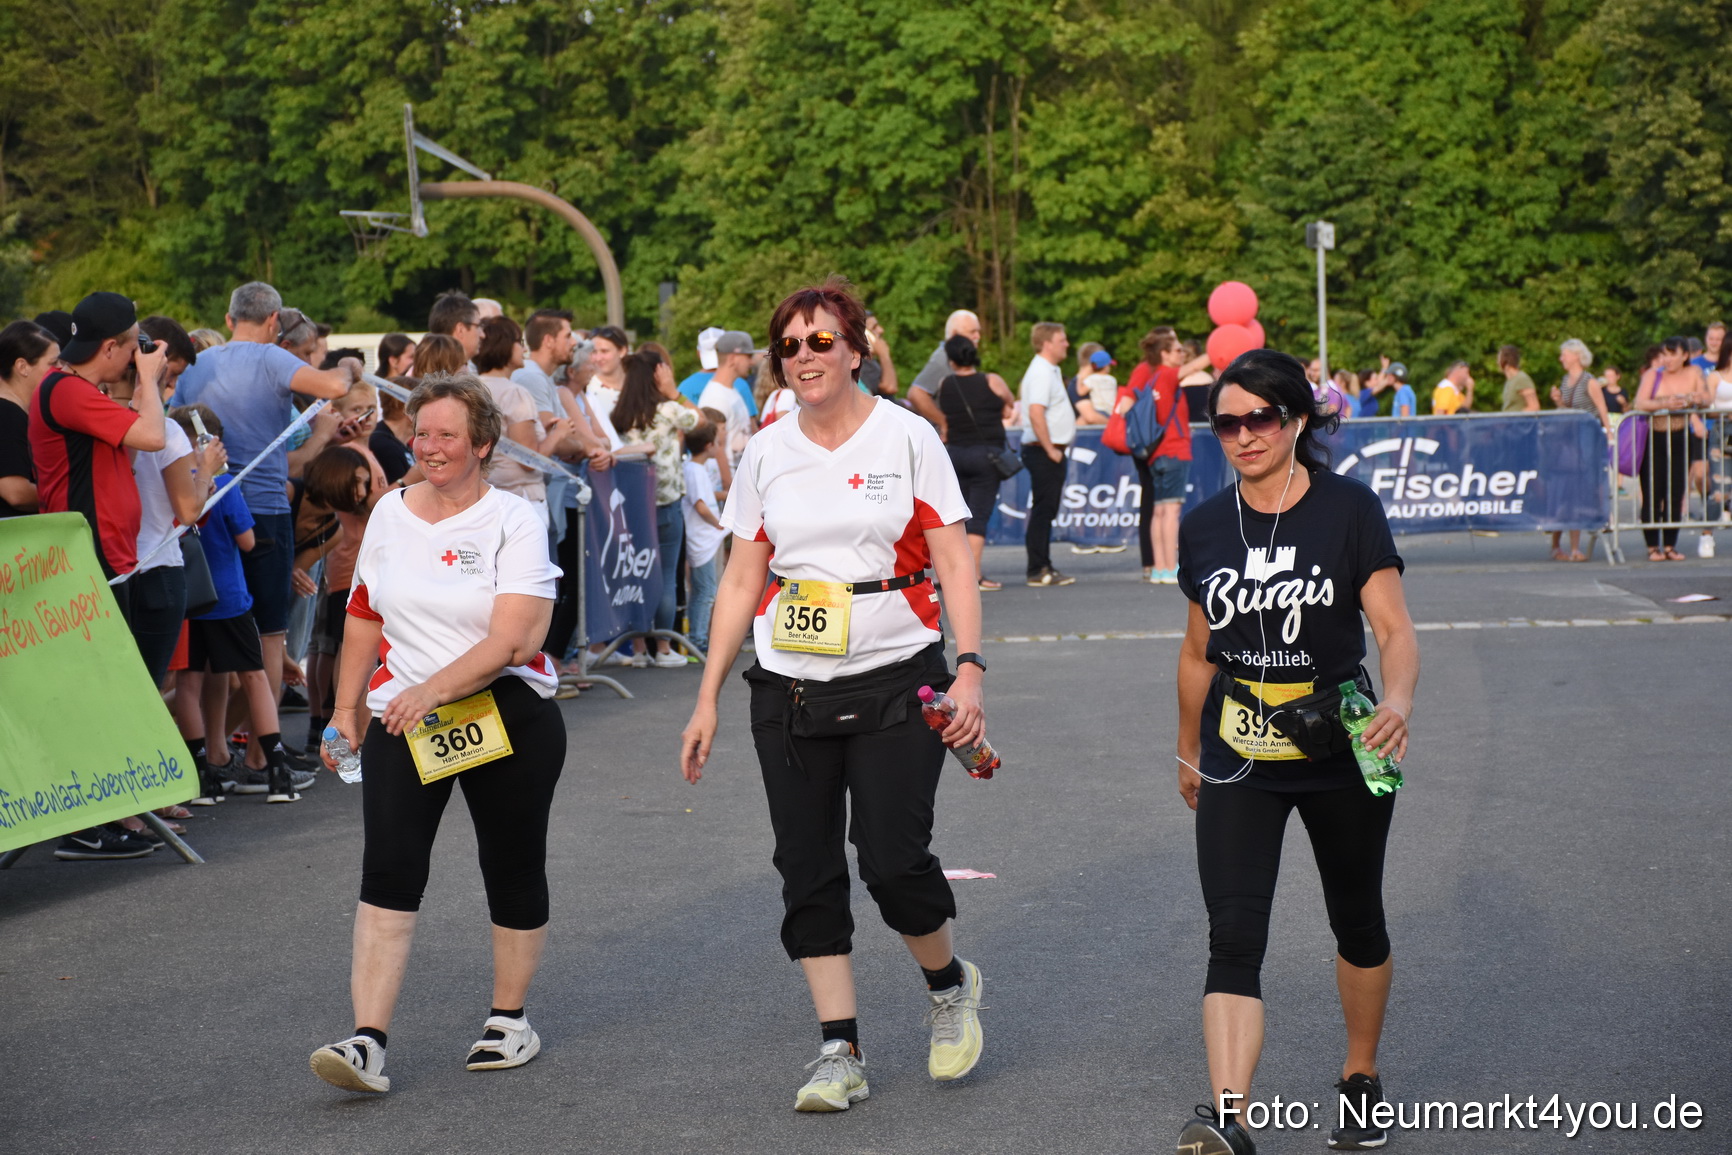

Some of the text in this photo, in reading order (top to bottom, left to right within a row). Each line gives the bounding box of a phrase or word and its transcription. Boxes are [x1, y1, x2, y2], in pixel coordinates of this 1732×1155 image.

[865, 492, 888, 504] Katja
[1371, 463, 1538, 501] Fischer
[1386, 499, 1524, 519] AUTOMOBILE
[15, 546, 73, 590] Firmen
[34, 575, 110, 641] länger!
[784, 605, 827, 633] 356
[1201, 564, 1334, 645] Burgis
[802, 633, 819, 641] Katja
[430, 722, 483, 758] 360
[442, 747, 484, 764] Härtl Marion
